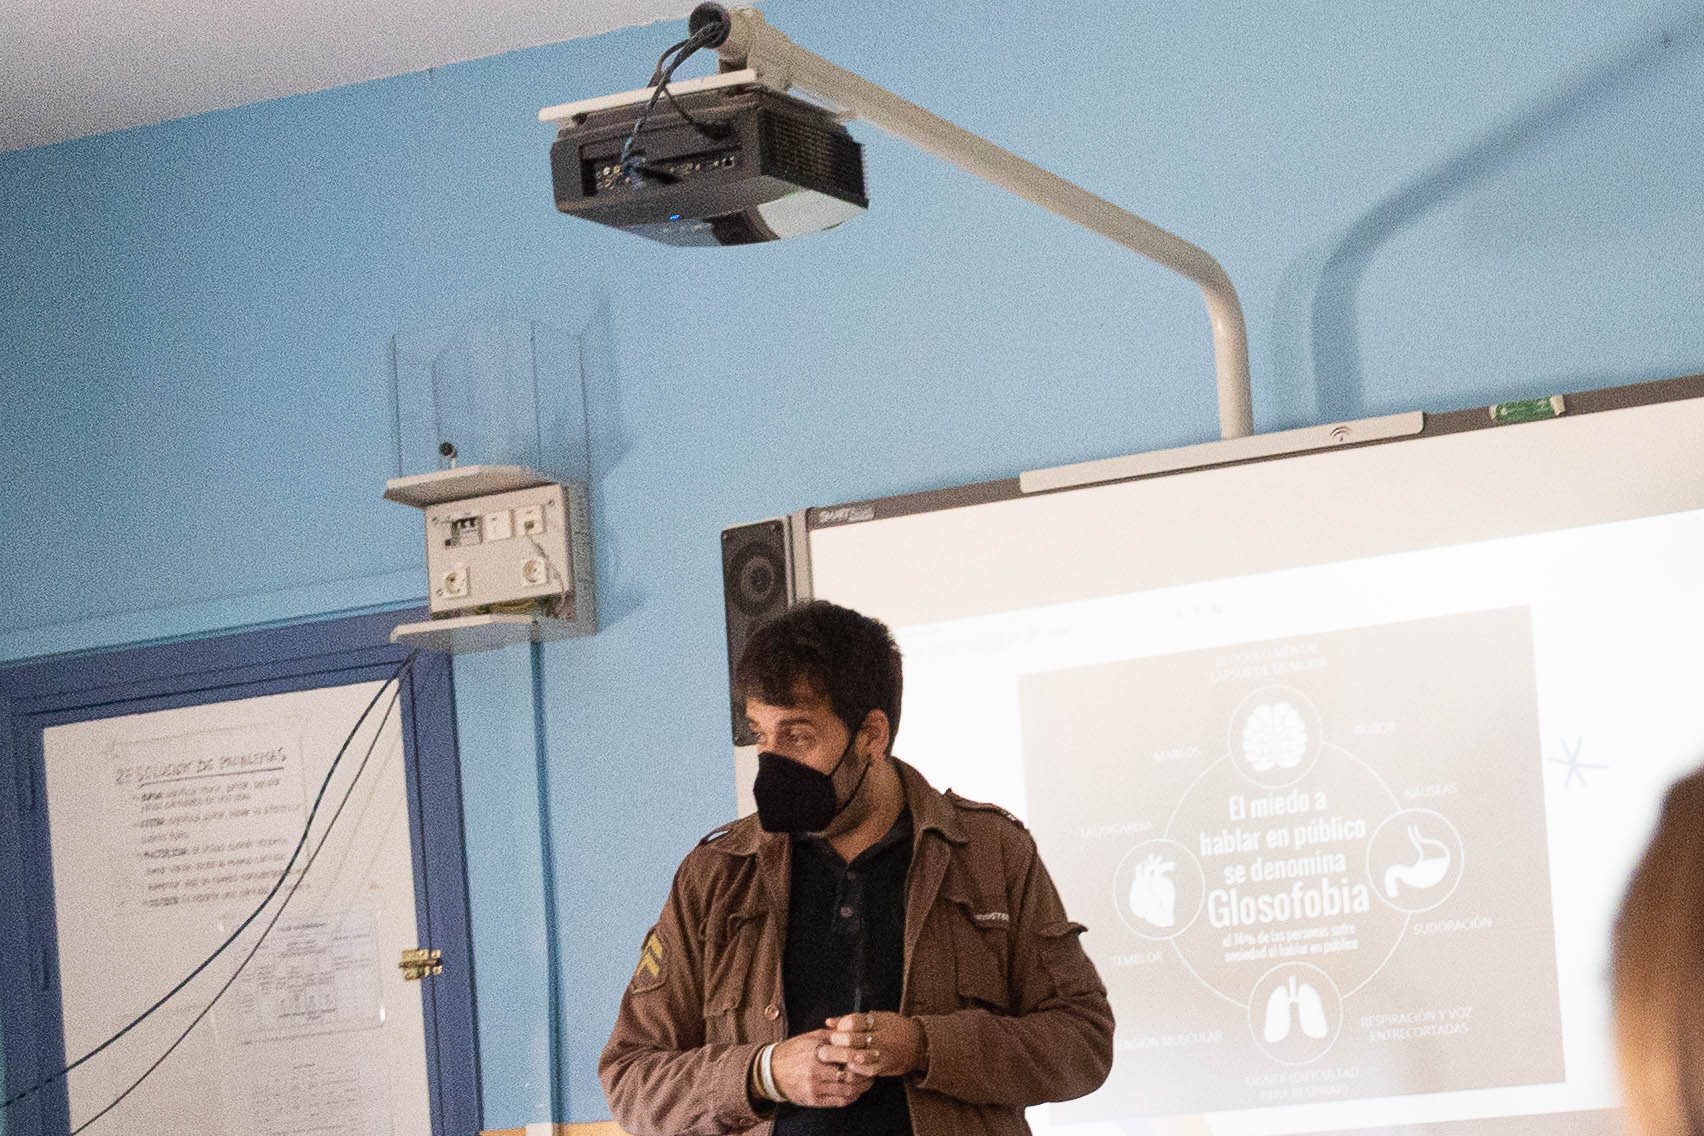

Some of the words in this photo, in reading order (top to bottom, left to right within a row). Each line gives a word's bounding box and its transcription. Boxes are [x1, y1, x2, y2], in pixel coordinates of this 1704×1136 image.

[1228, 794, 1246, 821] El
[1251, 790, 1310, 818] miedo
[1314, 791, 1327, 810] a
[1199, 827, 1261, 857] hablar
[1266, 828, 1289, 849] en
[1295, 816, 1366, 850] público
[1223, 863, 1246, 885] se
[1250, 850, 1347, 882] denomina
[1207, 878, 1371, 928] Glosofobia
[1412, 913, 1493, 936] SUDORACIÓN
[1360, 1008, 1436, 1028] RESPIRACIÓN
[1438, 1009, 1448, 1021] Y
[1448, 1006, 1473, 1020] VOZ
[1368, 1021, 1470, 1042] ENTRECORTADAS
